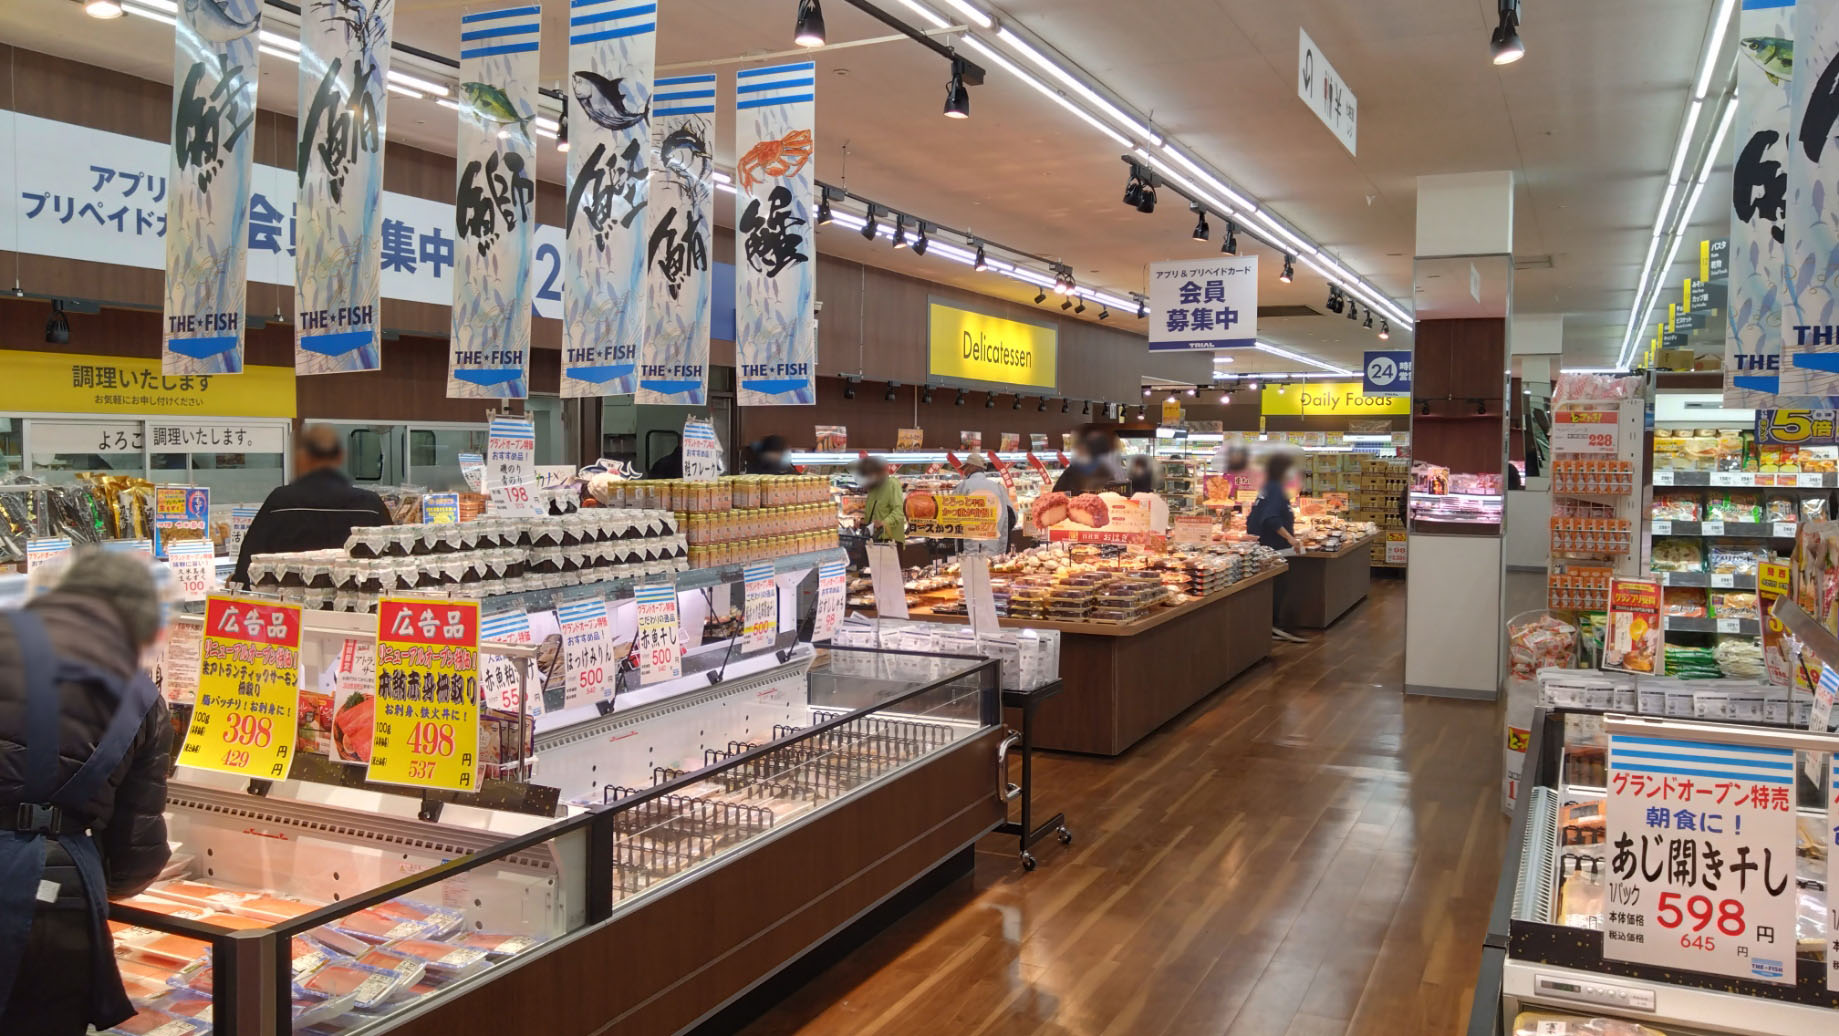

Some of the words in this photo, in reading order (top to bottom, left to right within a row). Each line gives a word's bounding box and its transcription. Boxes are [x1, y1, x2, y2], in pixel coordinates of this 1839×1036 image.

[1156, 270, 1179, 280] アプリ
[1180, 269, 1188, 278] &
[1190, 265, 1252, 278] プリペイドカード
[1179, 279, 1226, 305] 会員
[168, 314, 197, 333] THE
[205, 312, 239, 332] FISH
[300, 310, 330, 330] THE
[338, 305, 373, 325] FISH
[1166, 306, 1239, 333] 募集中
[1793, 325, 1839, 345] TH
[454, 351, 483, 365] THE
[491, 350, 523, 365] FISH
[567, 347, 595, 362] THE
[604, 344, 636, 361] FISH
[962, 330, 1033, 370] Delicatessen
[640, 364, 667, 377] THE
[673, 364, 703, 377] FISH
[741, 364, 769, 377] THE
[776, 362, 808, 376] FISH
[1370, 363, 1394, 379] 24
[1734, 354, 1779, 370] THE
[71, 364, 214, 392] 調理いたします
[1301, 392, 1339, 410] Daily
[1588, 433, 1612, 447] 228
[504, 487, 529, 502] 198
[184, 581, 205, 592] 100
[217, 605, 289, 639] 広告品
[391, 606, 465, 639] 広告品
[652, 648, 672, 666] 500
[484, 656, 535, 692] 赤魚粕け
[579, 667, 604, 689] 500
[501, 687, 529, 709] 55
[194, 711, 211, 725] 100g
[375, 721, 392, 735] 100g
[222, 711, 274, 749] 398
[276, 745, 288, 759] 円
[406, 721, 455, 758] 498
[461, 752, 472, 767] 円
[221, 748, 250, 768] 429
[271, 763, 284, 776] 円
[408, 760, 437, 779] 537
[459, 772, 471, 787] 円
[1612, 772, 1790, 812] グランドオープン特売
[1646, 806, 1742, 836] 朝食に！
[1611, 831, 1788, 897] あじ開き干し
[1609, 882, 1641, 907] 1パック
[1608, 910, 1645, 928] 本体価格
[1656, 892, 1746, 937] 598
[1756, 925, 1775, 944] 円
[1608, 930, 1645, 944] 税込価格
[1680, 933, 1716, 952] 645
[1736, 945, 1749, 958] 円
